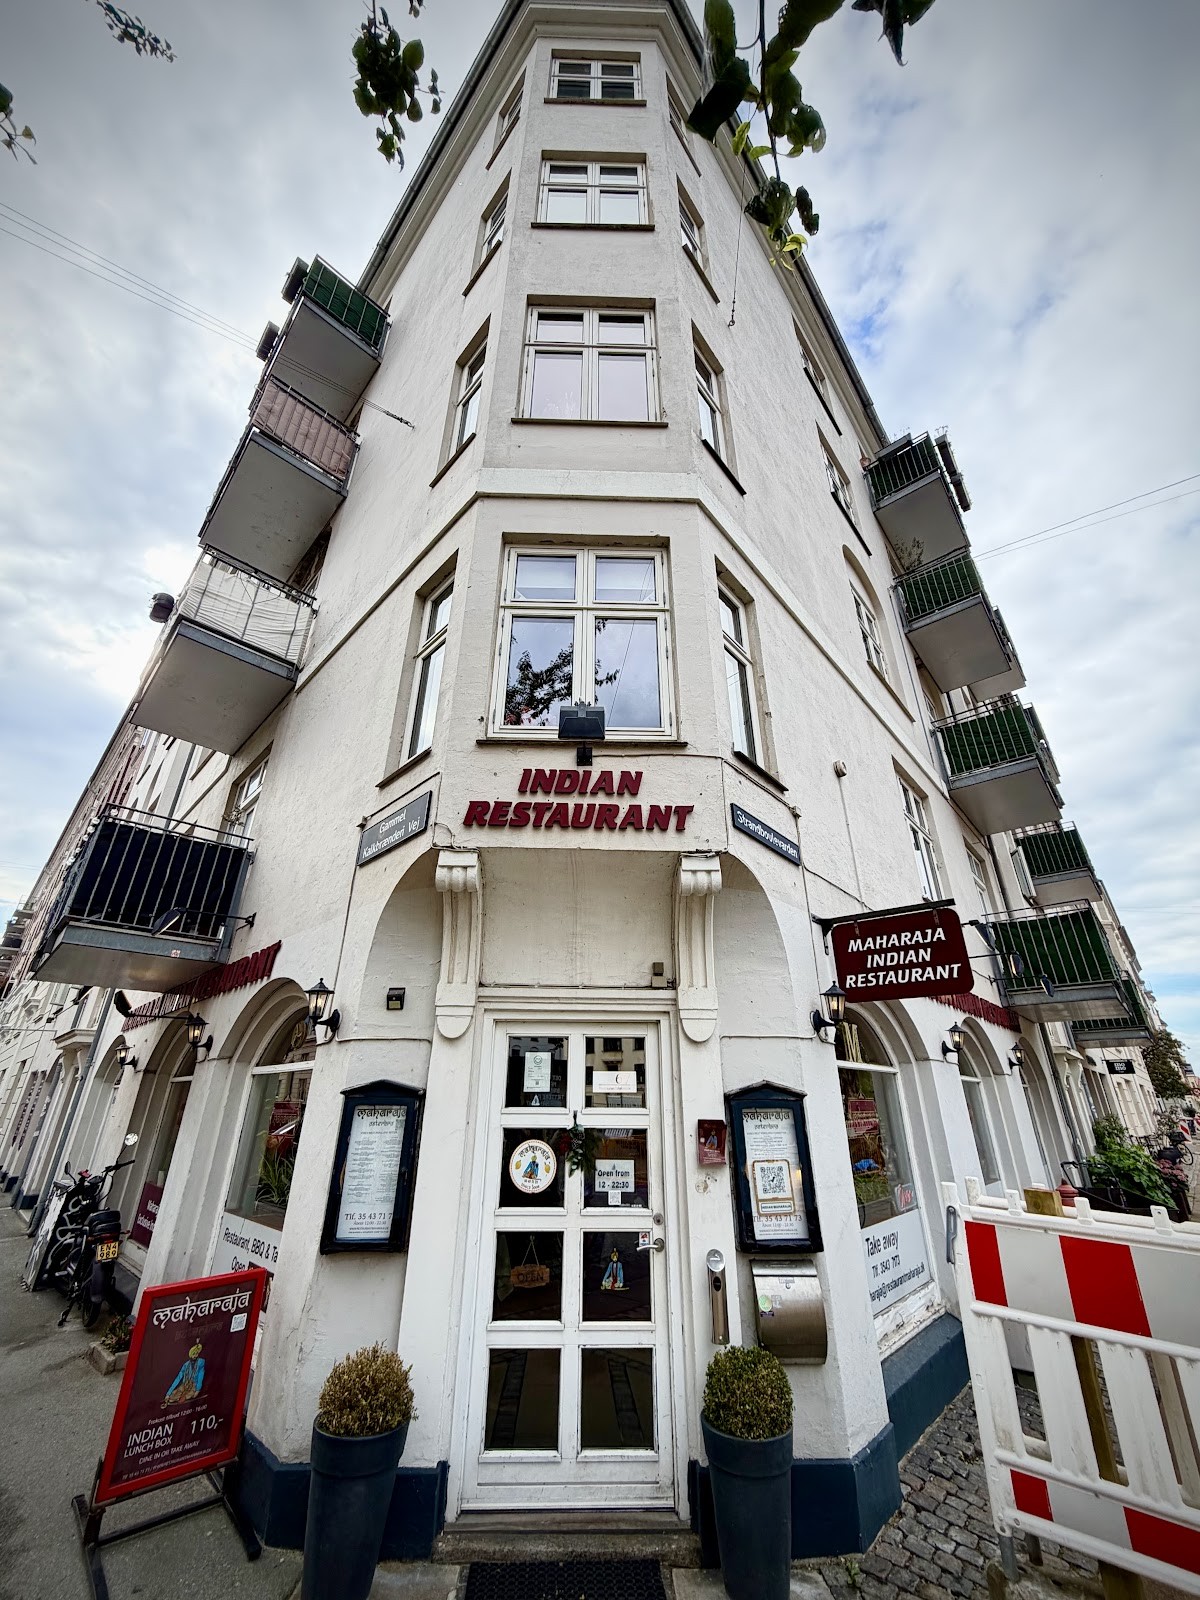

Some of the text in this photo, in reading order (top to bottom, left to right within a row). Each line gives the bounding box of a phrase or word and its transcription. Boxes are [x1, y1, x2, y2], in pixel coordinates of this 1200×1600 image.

[518, 768, 643, 796] INDIAN
[380, 809, 406, 833] Gammel
[463, 801, 695, 832] RESTAURANT
[362, 816, 421, 859] Kalkbrænderi Vej
[737, 810, 798, 858] Strandboulevarden
[848, 927, 946, 952] MAHARAJA
[866, 948, 931, 968] INDIAN
[845, 963, 961, 988] RESTAURANT
[611, 1181, 630, 1189] 22:30
[223, 1227, 250, 1254] Restaurant,
[251, 1238, 265, 1259] BBQ
[265, 1243, 271, 1259] &
[865, 1231, 899, 1257] Take away
[880, 1259, 891, 1275] 3543
[153, 1288, 252, 1329] maharaja
[123, 1436, 173, 1458] LUNCH BOX
[127, 1422, 174, 1447] INDIAN
[138, 1455, 153, 1465] DINE
[170, 1444, 184, 1455] TAKE
[183, 1440, 201, 1450] AWAY
